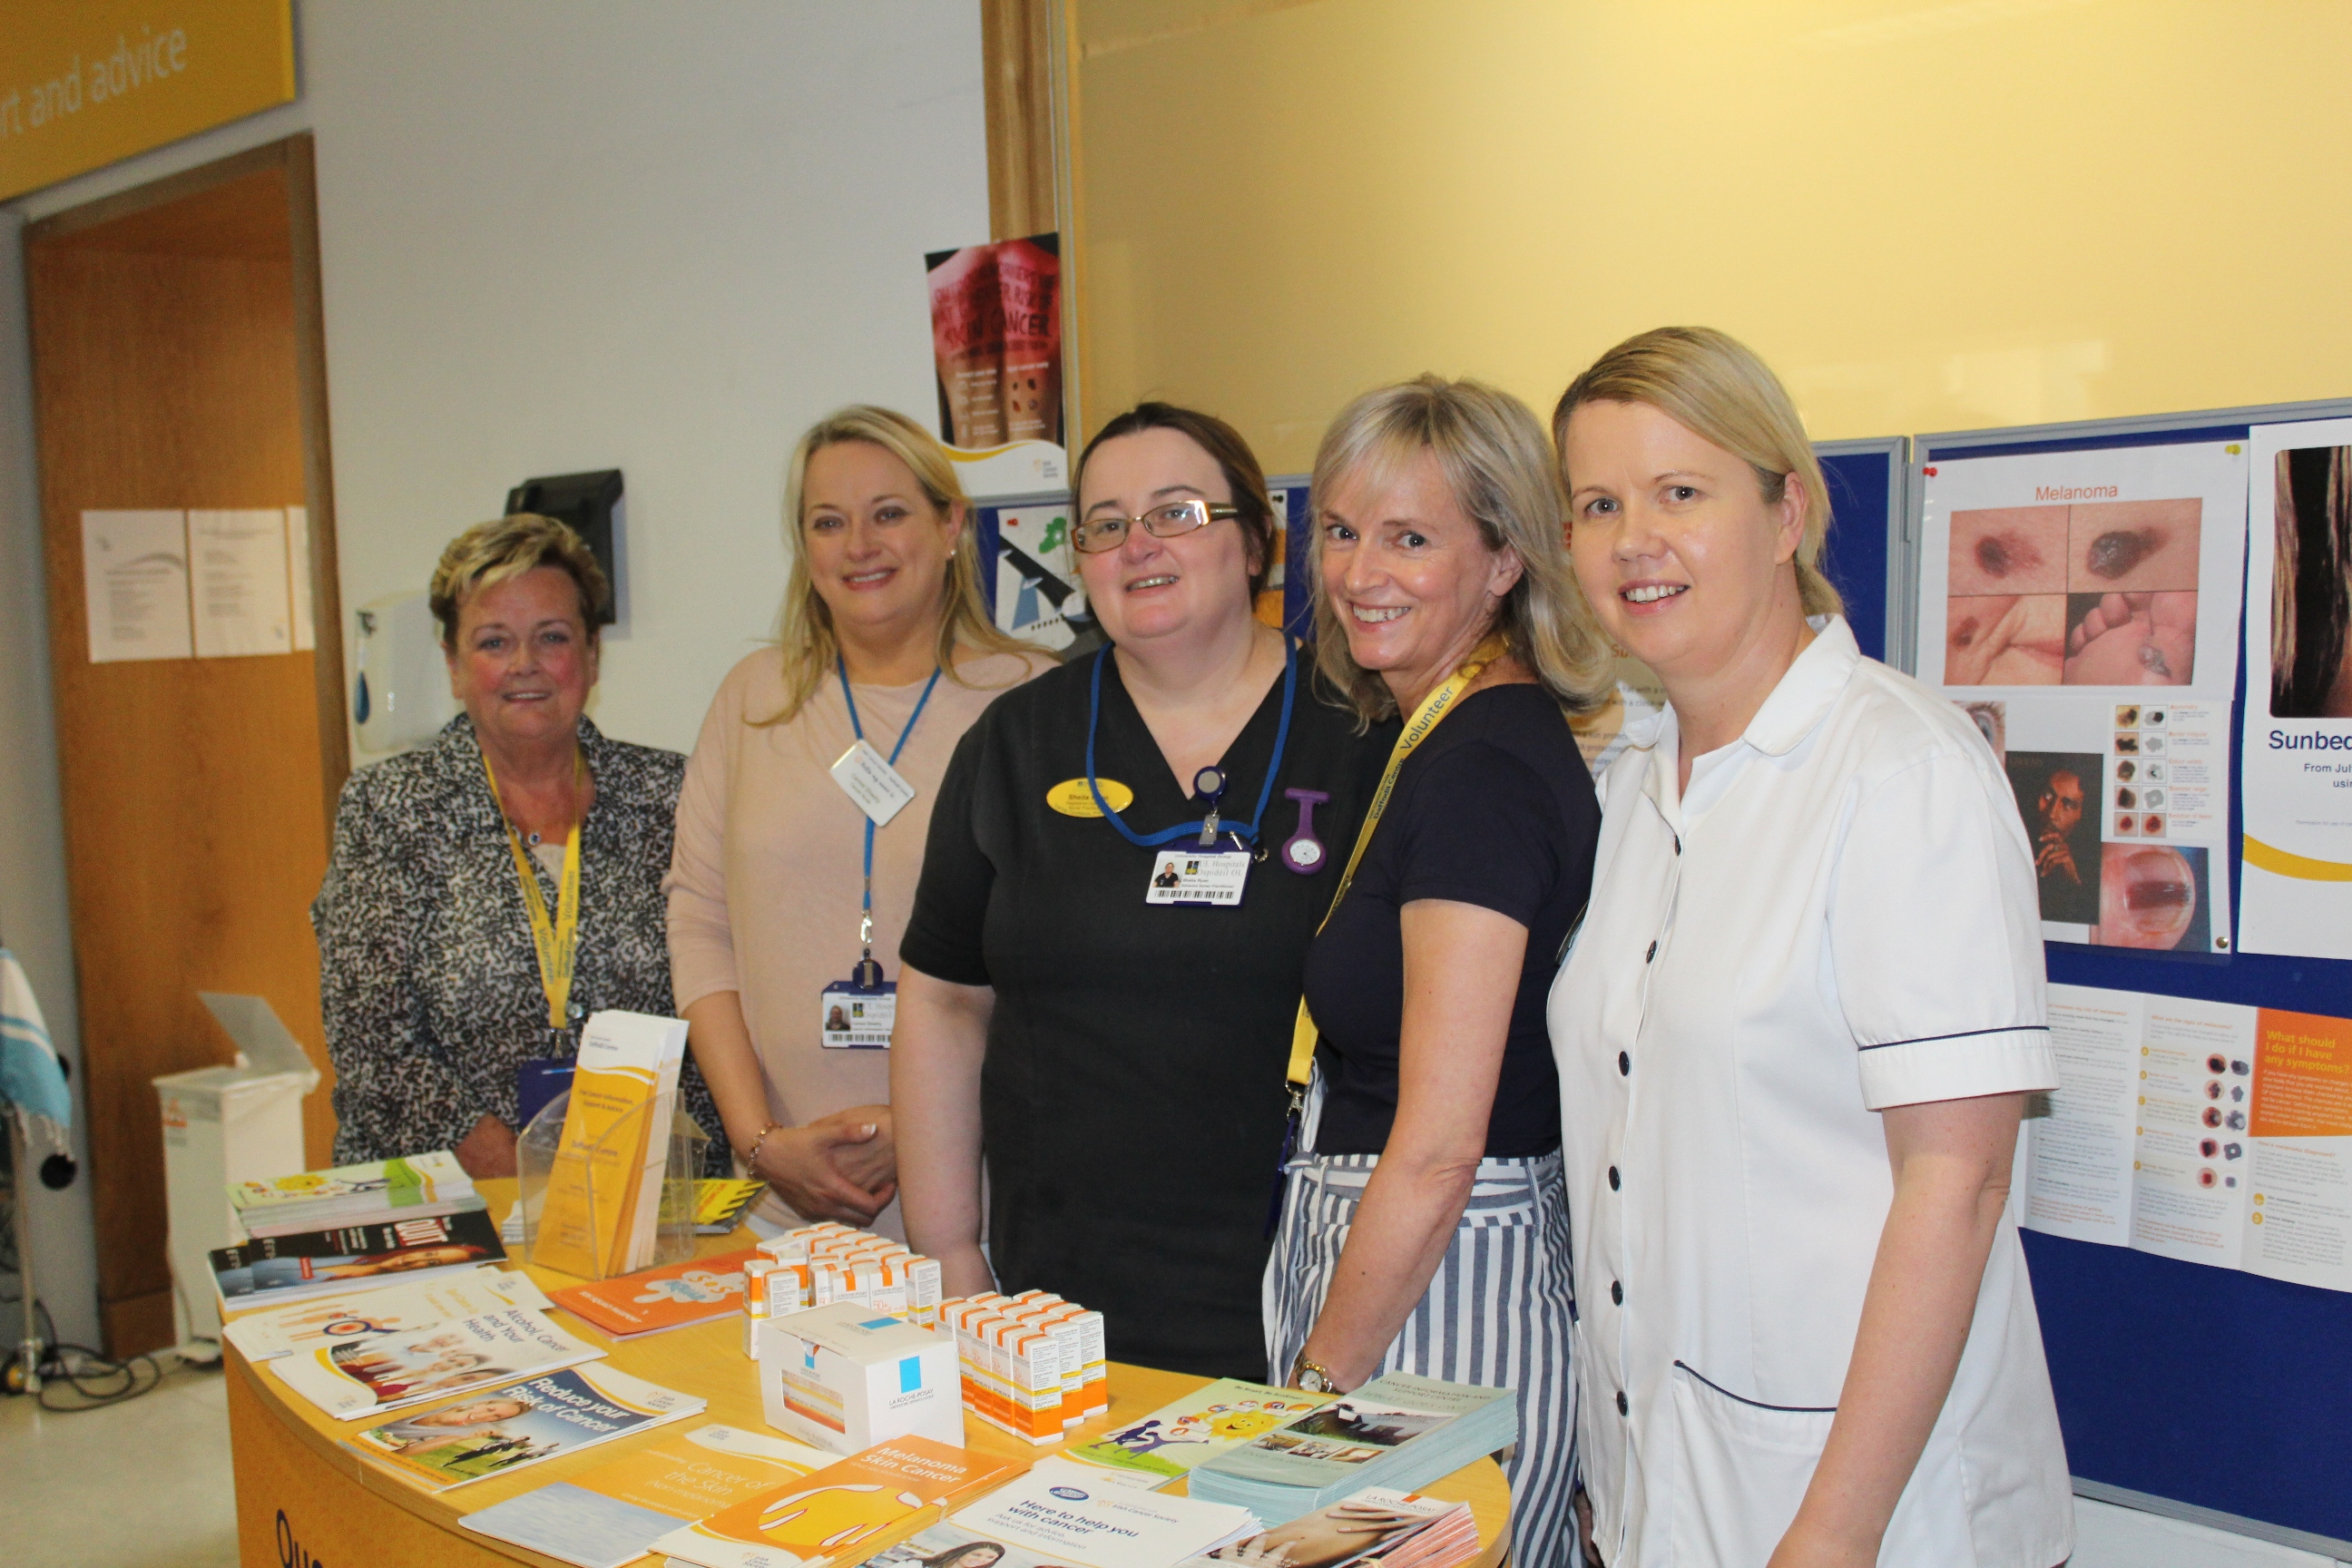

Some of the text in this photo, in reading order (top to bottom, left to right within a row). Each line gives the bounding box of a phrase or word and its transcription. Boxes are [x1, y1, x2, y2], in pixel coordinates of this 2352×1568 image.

[29, 55, 83, 129] and
[91, 24, 188, 103] advice
[2034, 483, 2119, 501] Melanoma
[1400, 686, 1454, 750] Volunteer
[2304, 763, 2352, 774] From Jul
[1373, 786, 1391, 819] Daffodil
[1387, 758, 1405, 785] Centre
[2268, 1030, 2337, 1049] What should
[2271, 1043, 2286, 1054] do
[2288, 1044, 2297, 1054] if
[2306, 1047, 2333, 1060] have
[2264, 1055, 2350, 1074] any symptoms?
[394, 1218, 449, 1246] QUIT
[463, 1318, 495, 1343] Health
[483, 1313, 524, 1344] and Your
[504, 1308, 571, 1353] Alcohol, Cancer
[528, 1377, 631, 1419] Reduce your
[897, 1388, 934, 1403] ROCHE-POSAY
[1379, 1379, 1412, 1389] CANCER
[503, 1385, 619, 1433] Risk of Cancer
[860, 1454, 962, 1484] Skin Cancer
[876, 1446, 967, 1475] Melanoma
[664, 1471, 733, 1496] the Skin
[687, 1462, 777, 1490] Cancer of
[995, 1513, 1012, 1521] Ask
[1008, 1506, 1094, 1534] with cancer
[1019, 1500, 1140, 1537] Here to help you
[1128, 1507, 1153, 1517] Cancer
[1152, 1514, 1180, 1524] Society
[276, 1508, 324, 1568] Qu
[986, 1516, 1087, 1550] support and information
